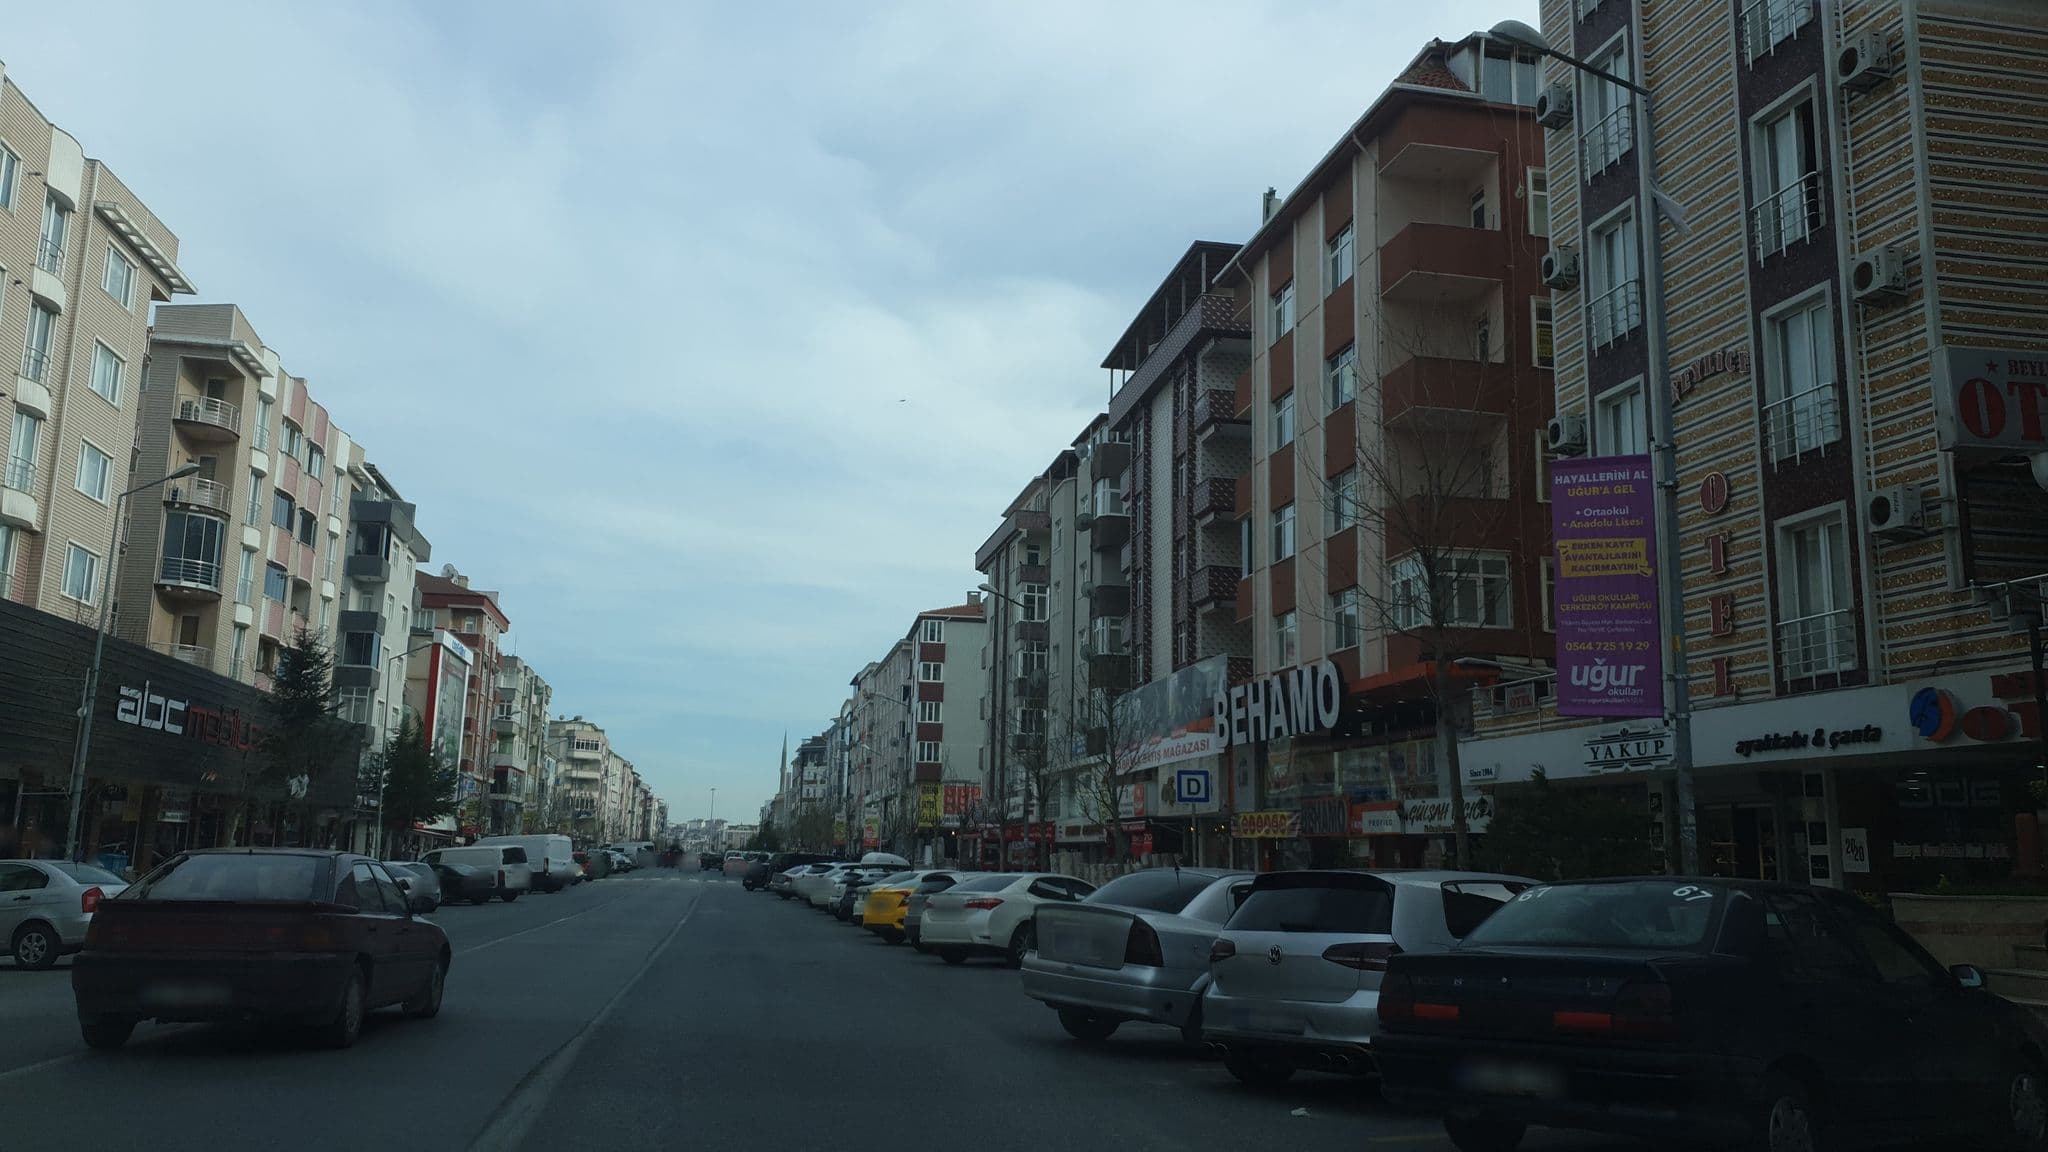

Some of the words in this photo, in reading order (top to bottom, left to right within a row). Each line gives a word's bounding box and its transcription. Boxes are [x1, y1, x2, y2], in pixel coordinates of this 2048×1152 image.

[1555, 470, 1630, 485] HAYALLERİNİ
[1633, 471, 1648, 480] AL
[1567, 486, 1611, 497] UĞUR'A
[1613, 484, 1636, 494] GEL
[1583, 505, 1630, 517] Ortaokul
[1569, 519, 1613, 530] Anadolu
[1615, 517, 1644, 527] Lisesi
[1700, 471, 1736, 698] OTEL
[1595, 642, 1617, 651] 725
[1621, 641, 1634, 650] 19
[1570, 657, 1646, 692] uğur
[1607, 688, 1644, 696] okulları
[117, 680, 189, 735] abc
[1214, 658, 1341, 750] BEHAMO
[1812, 728, 1826, 747] &
[1590, 740, 1664, 761] YAKUP
[1187, 778, 1201, 796] D
[1518, 886, 1553, 901] 67
[1672, 885, 1713, 901] 67
